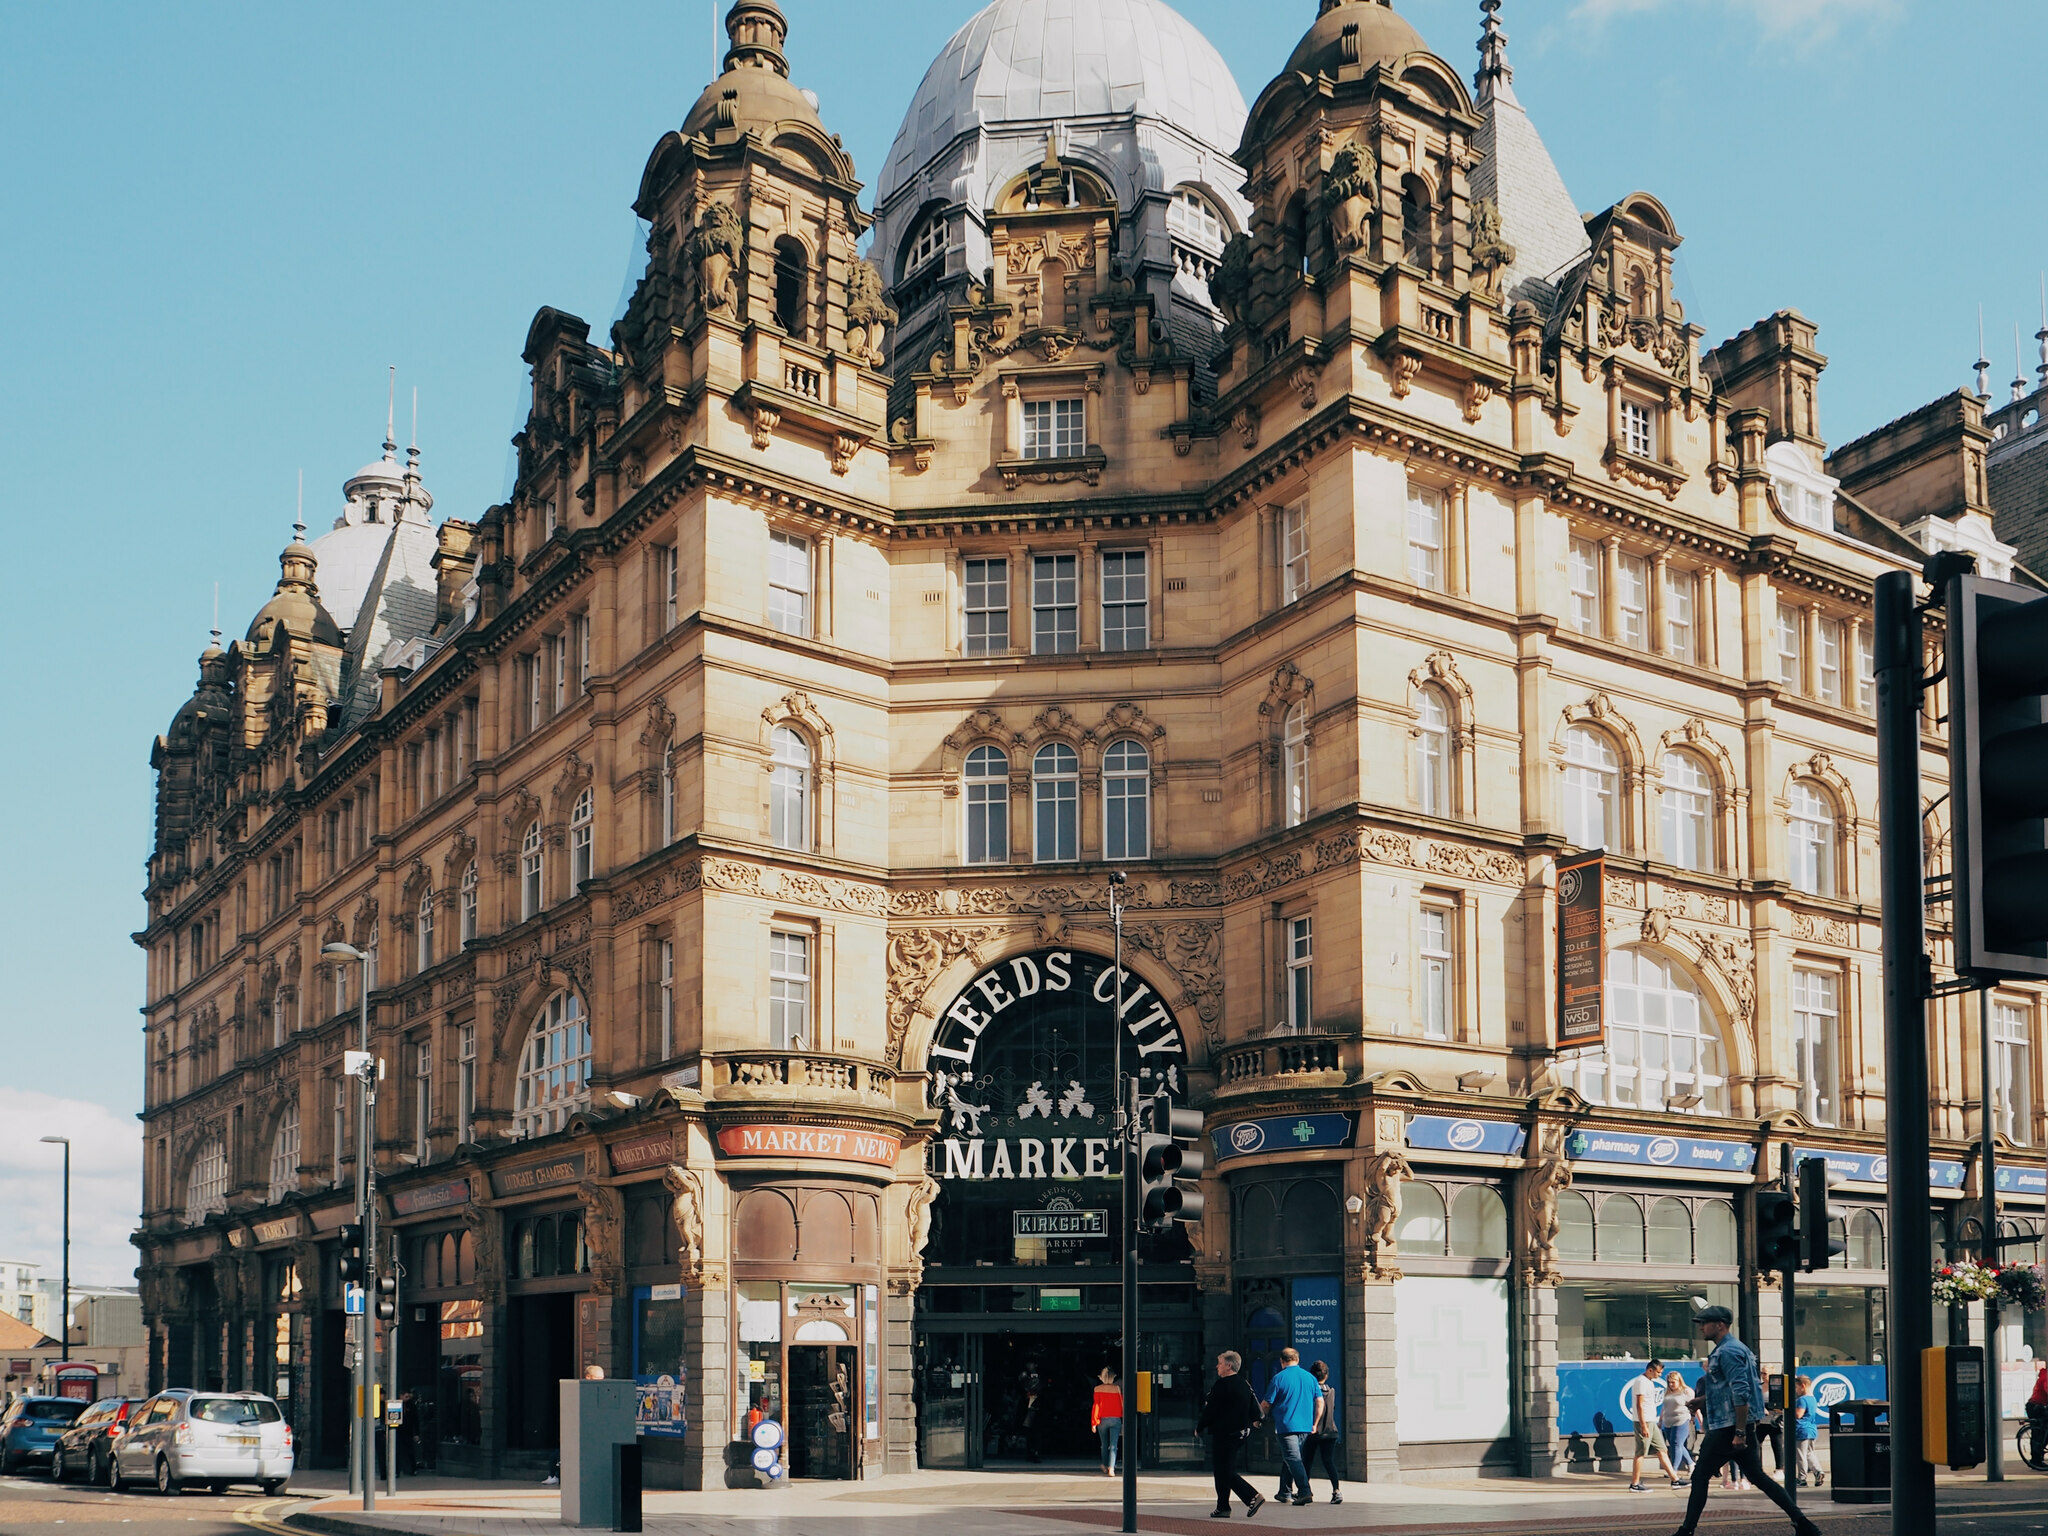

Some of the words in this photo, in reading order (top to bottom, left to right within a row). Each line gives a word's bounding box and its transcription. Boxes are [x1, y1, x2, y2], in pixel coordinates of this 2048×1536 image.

[1564, 912, 1596, 926] LEEMING
[1565, 906, 1580, 915] THE
[1564, 923, 1599, 937] BUILDING
[1565, 944, 1576, 952] TO
[1576, 940, 1590, 950] LET
[931, 952, 1071, 1064] LEEDS
[1093, 965, 1182, 1058] CITY
[1566, 1008, 1590, 1023] wsb
[614, 1144, 646, 1166] MARKET
[650, 1141, 671, 1158] NEWS
[742, 1130, 846, 1154] MARKET
[853, 1136, 896, 1161] NEWS
[1591, 1138, 1640, 1156] pharmacy
[1692, 1146, 1724, 1162] beauty
[943, 1137, 1124, 1179] MARKE
[1825, 1154, 1860, 1173] harmacy
[504, 1171, 535, 1190] LUDGATE
[535, 1162, 575, 1186] CHAMBERS
[1038, 1186, 1066, 1203] LEEDS
[1067, 1189, 1084, 1203] CITY
[1020, 1216, 1101, 1232] KIRKGATE
[1039, 1239, 1084, 1248] MARKET
[1294, 1298, 1337, 1307] welcome
[1818, 1383, 1847, 1407] Boots
